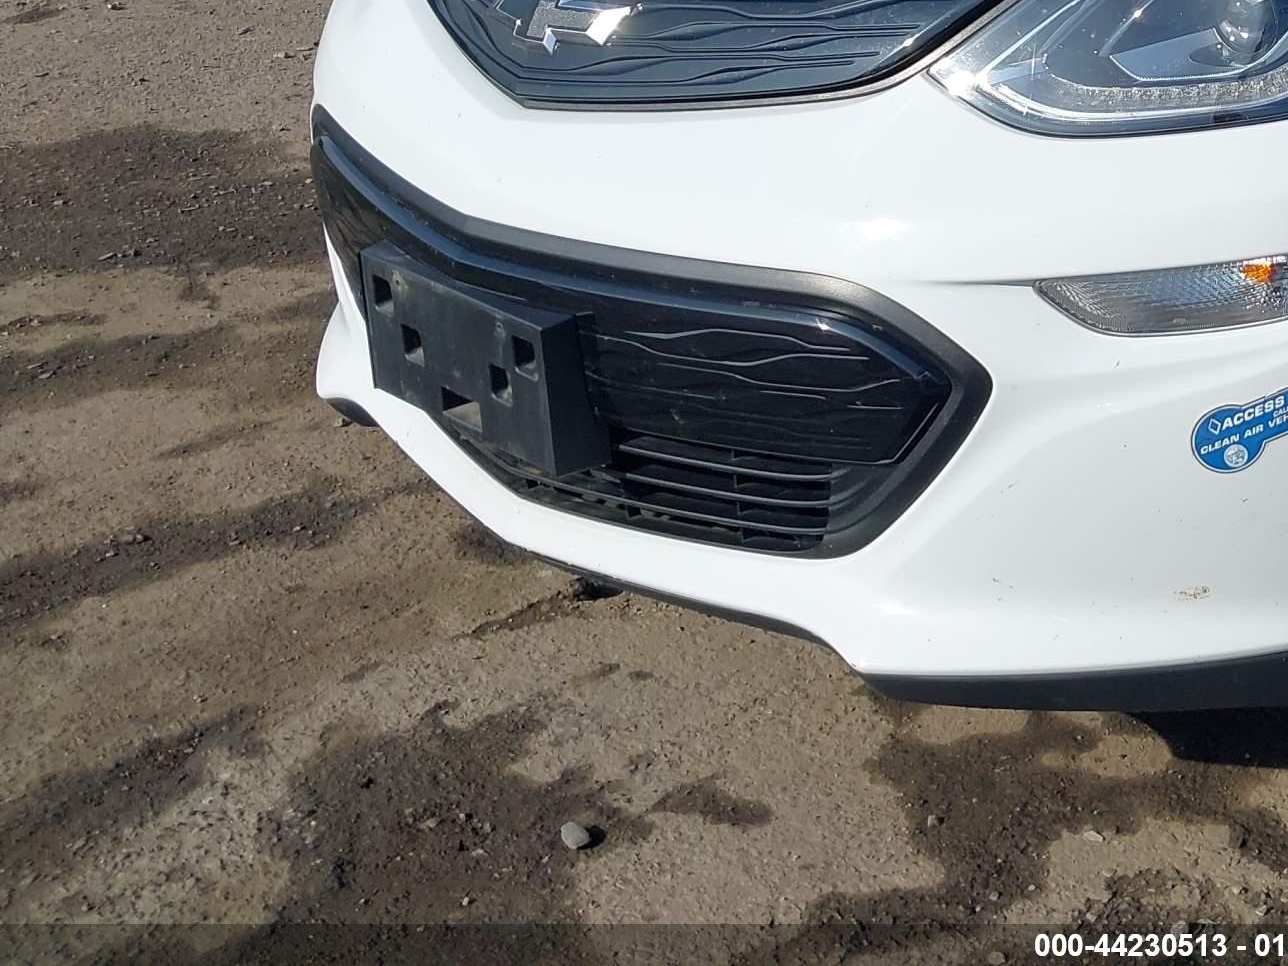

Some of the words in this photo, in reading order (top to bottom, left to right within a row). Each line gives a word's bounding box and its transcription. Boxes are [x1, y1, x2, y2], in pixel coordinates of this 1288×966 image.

[1222, 395, 1285, 431] ACCESS
[1200, 433, 1240, 456] CLEAN
[1243, 424, 1265, 439] AIR
